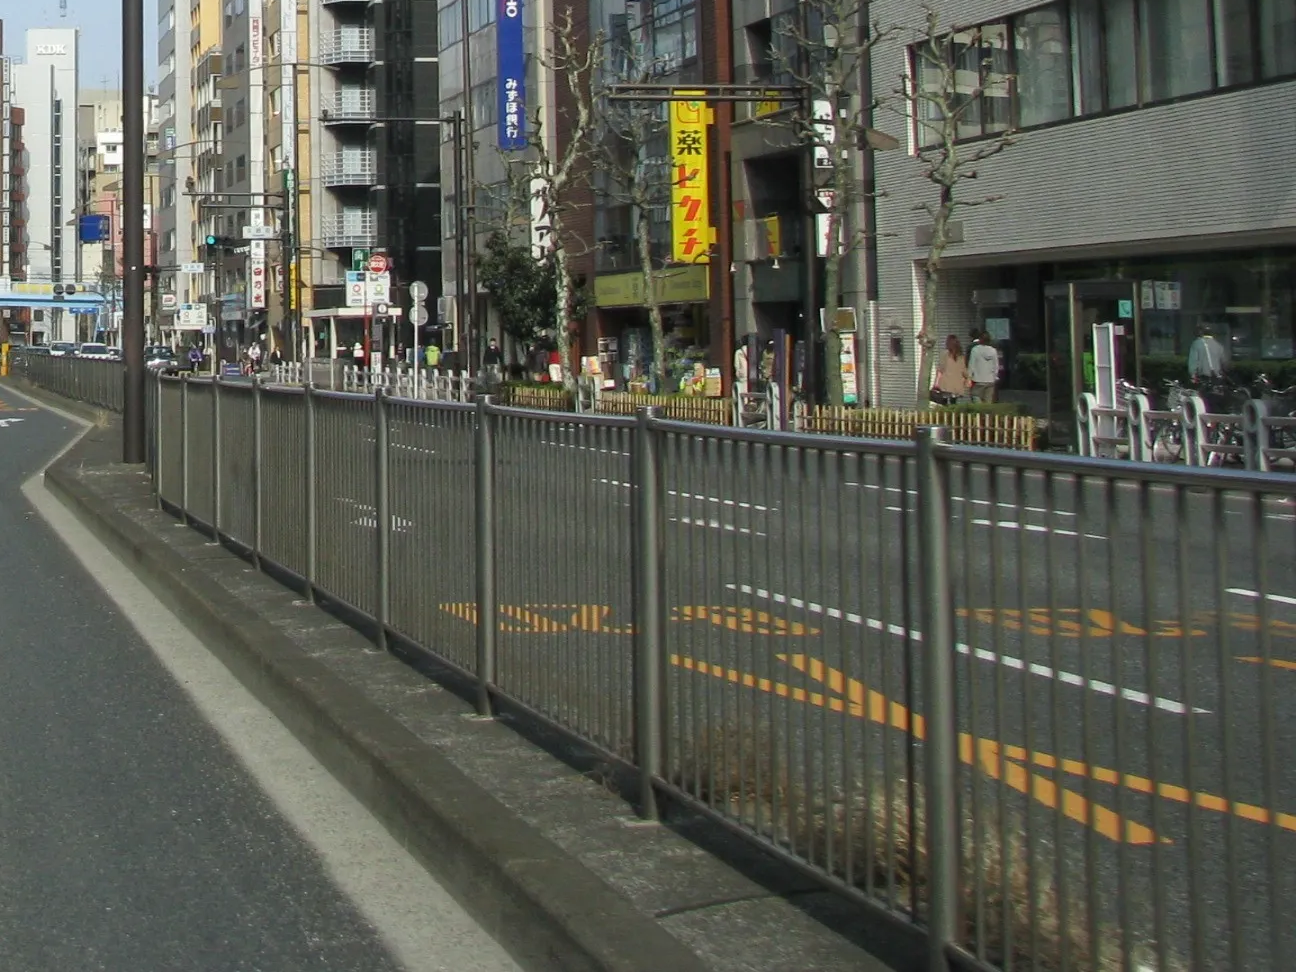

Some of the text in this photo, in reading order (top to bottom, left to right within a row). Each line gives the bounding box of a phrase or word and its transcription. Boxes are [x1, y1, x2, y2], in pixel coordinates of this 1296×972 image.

[36, 44, 65, 55] KDK
[505, 78, 519, 139] みずほ銀行
